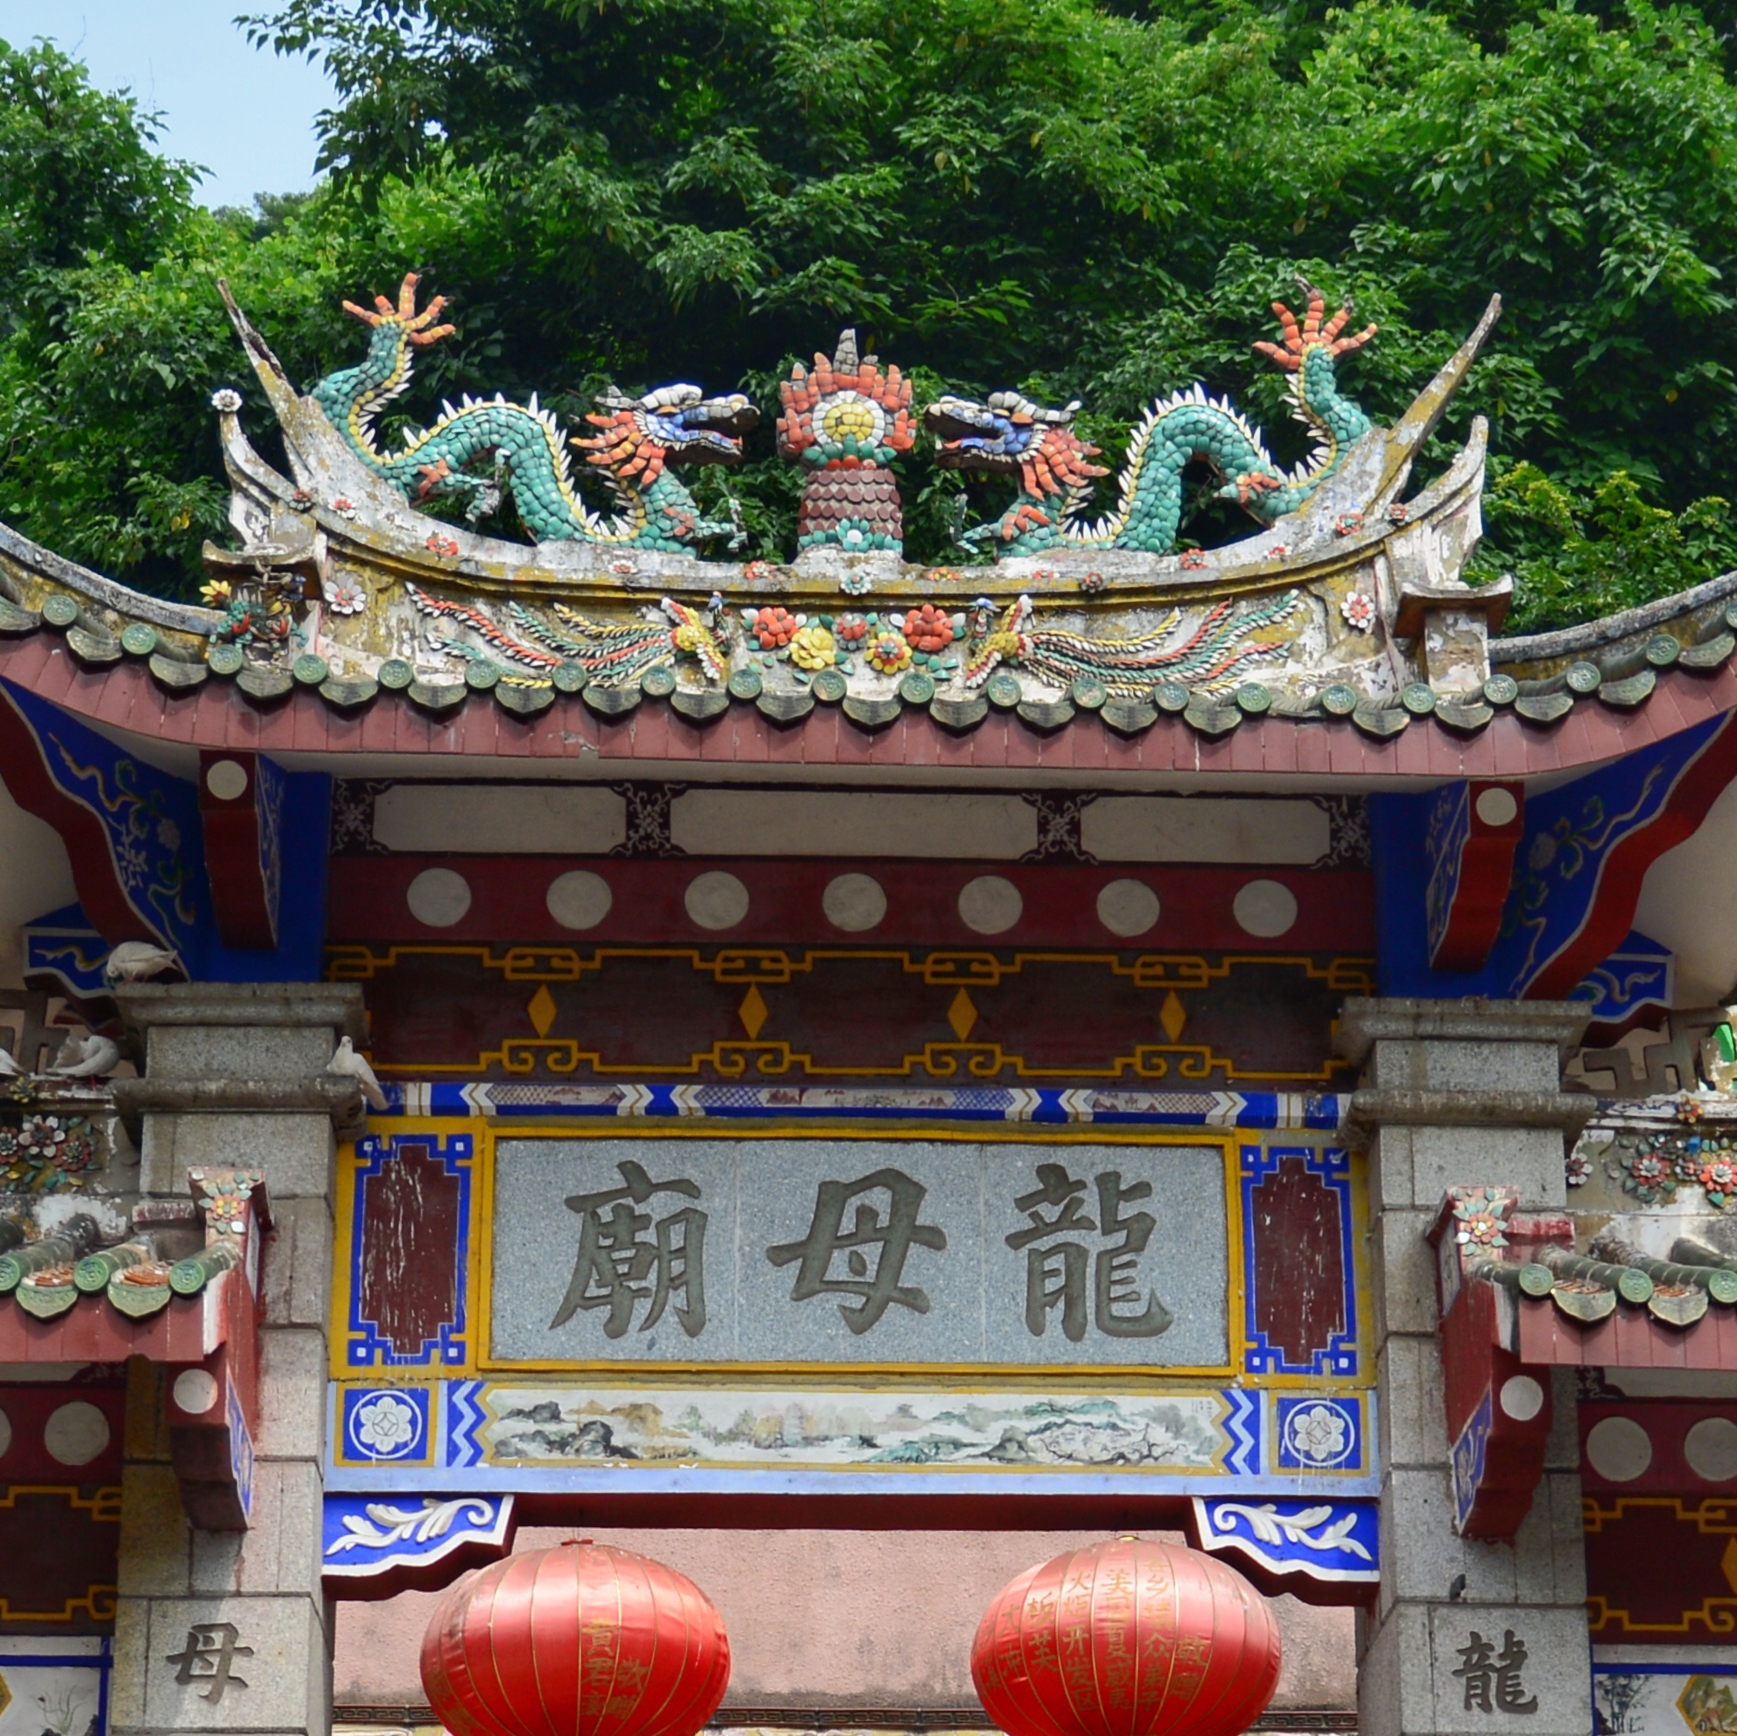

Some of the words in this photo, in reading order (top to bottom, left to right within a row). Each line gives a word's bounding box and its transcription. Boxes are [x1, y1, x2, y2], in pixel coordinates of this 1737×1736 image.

[549, 1159, 1174, 1341] 龍母廟
[1101, 1567, 1136, 1711] 美国夏威夷
